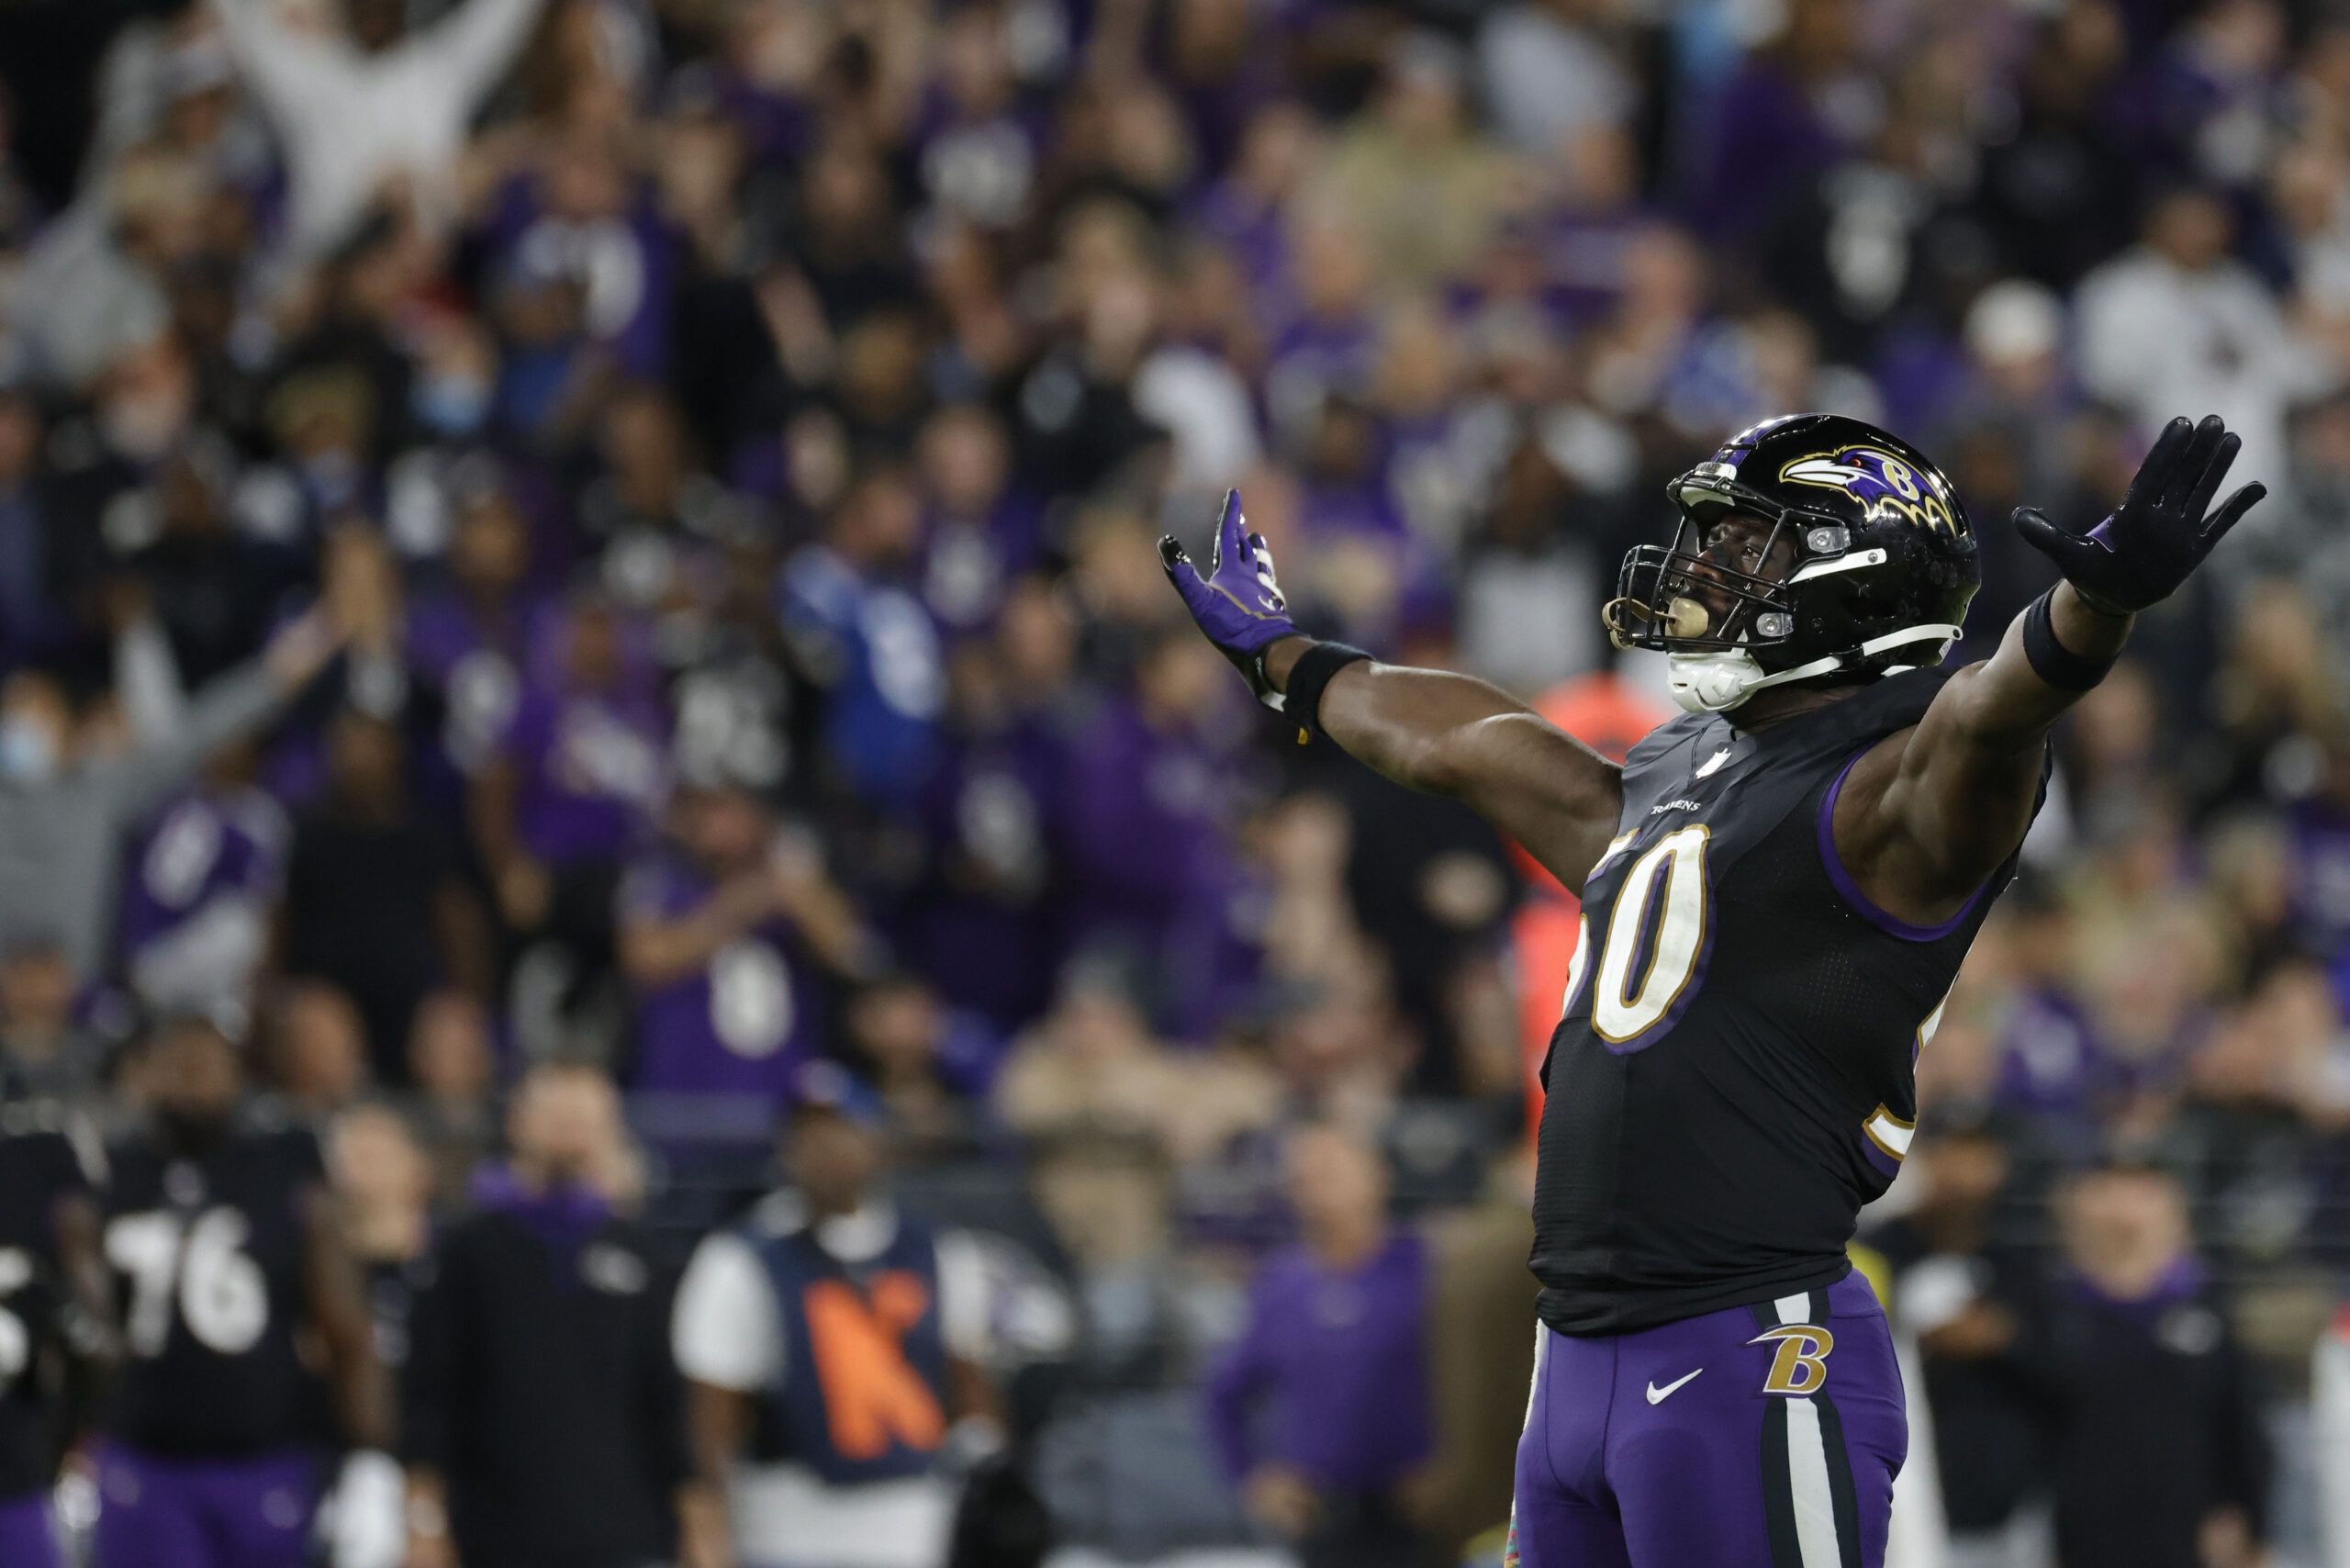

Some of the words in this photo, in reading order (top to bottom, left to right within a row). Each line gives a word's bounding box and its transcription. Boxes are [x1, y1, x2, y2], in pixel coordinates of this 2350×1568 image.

[103, 1206, 271, 1358] 76
[802, 1270, 949, 1462] K
[1746, 1324, 1834, 1394] B
